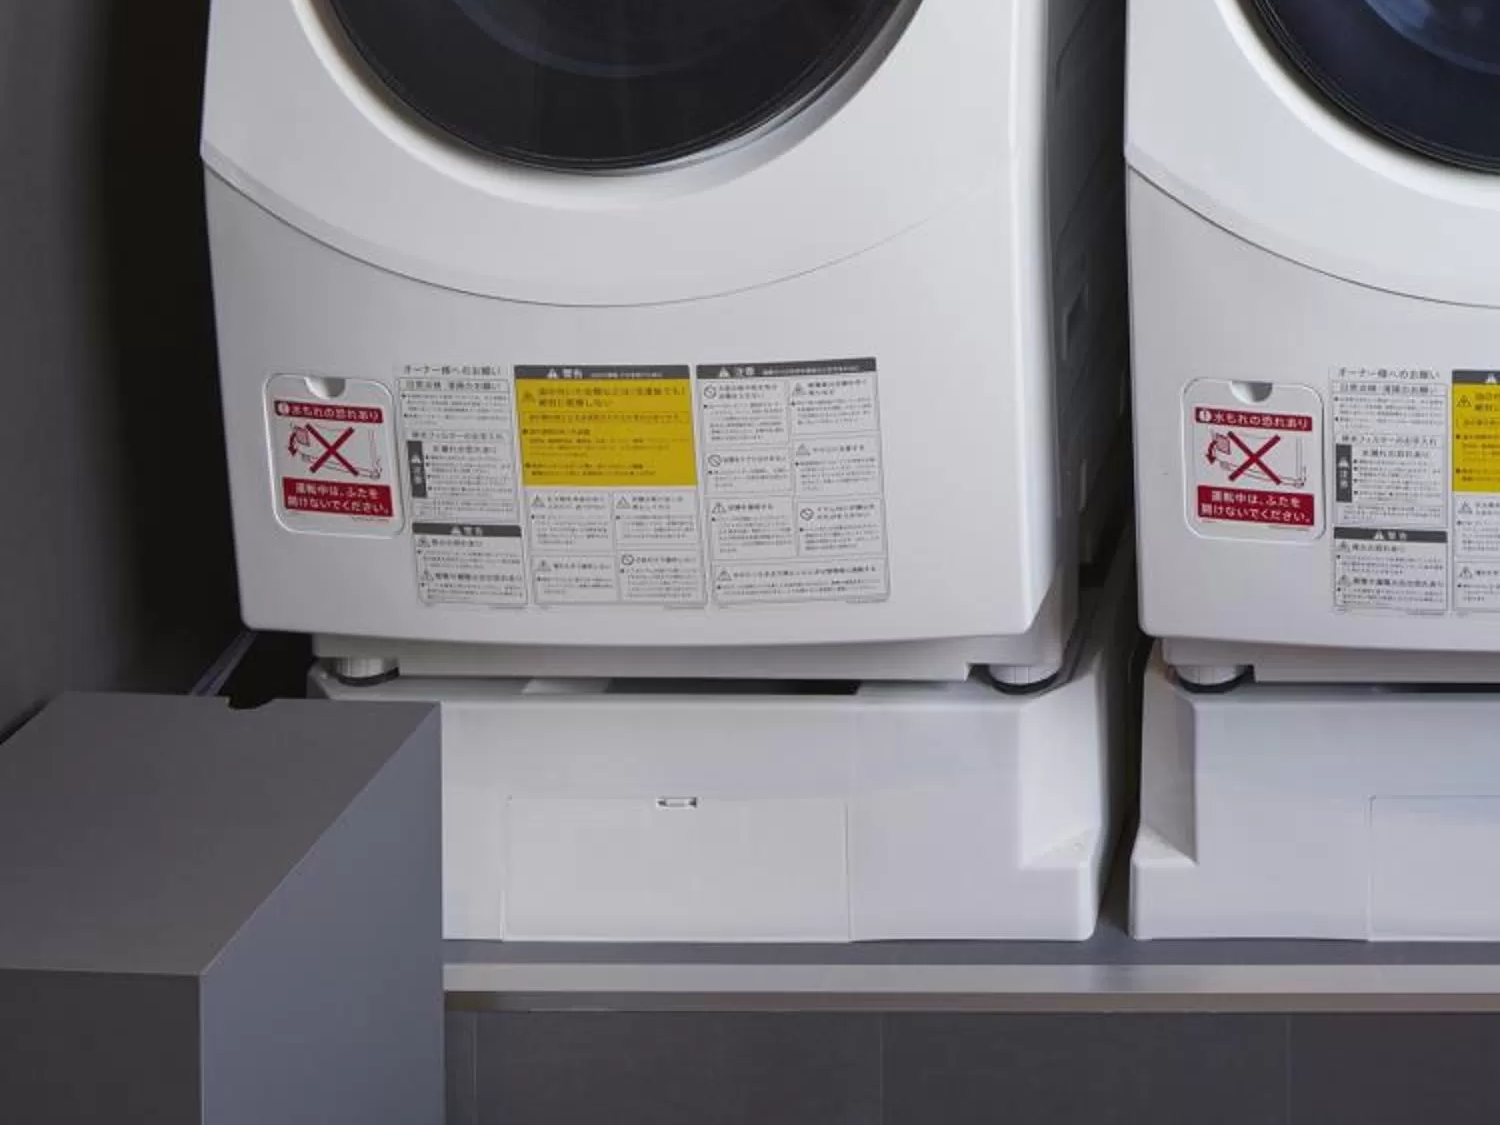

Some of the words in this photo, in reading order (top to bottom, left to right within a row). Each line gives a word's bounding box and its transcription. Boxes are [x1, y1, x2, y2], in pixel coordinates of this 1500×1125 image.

[1201, 503, 1313, 524] 開けないでください。
